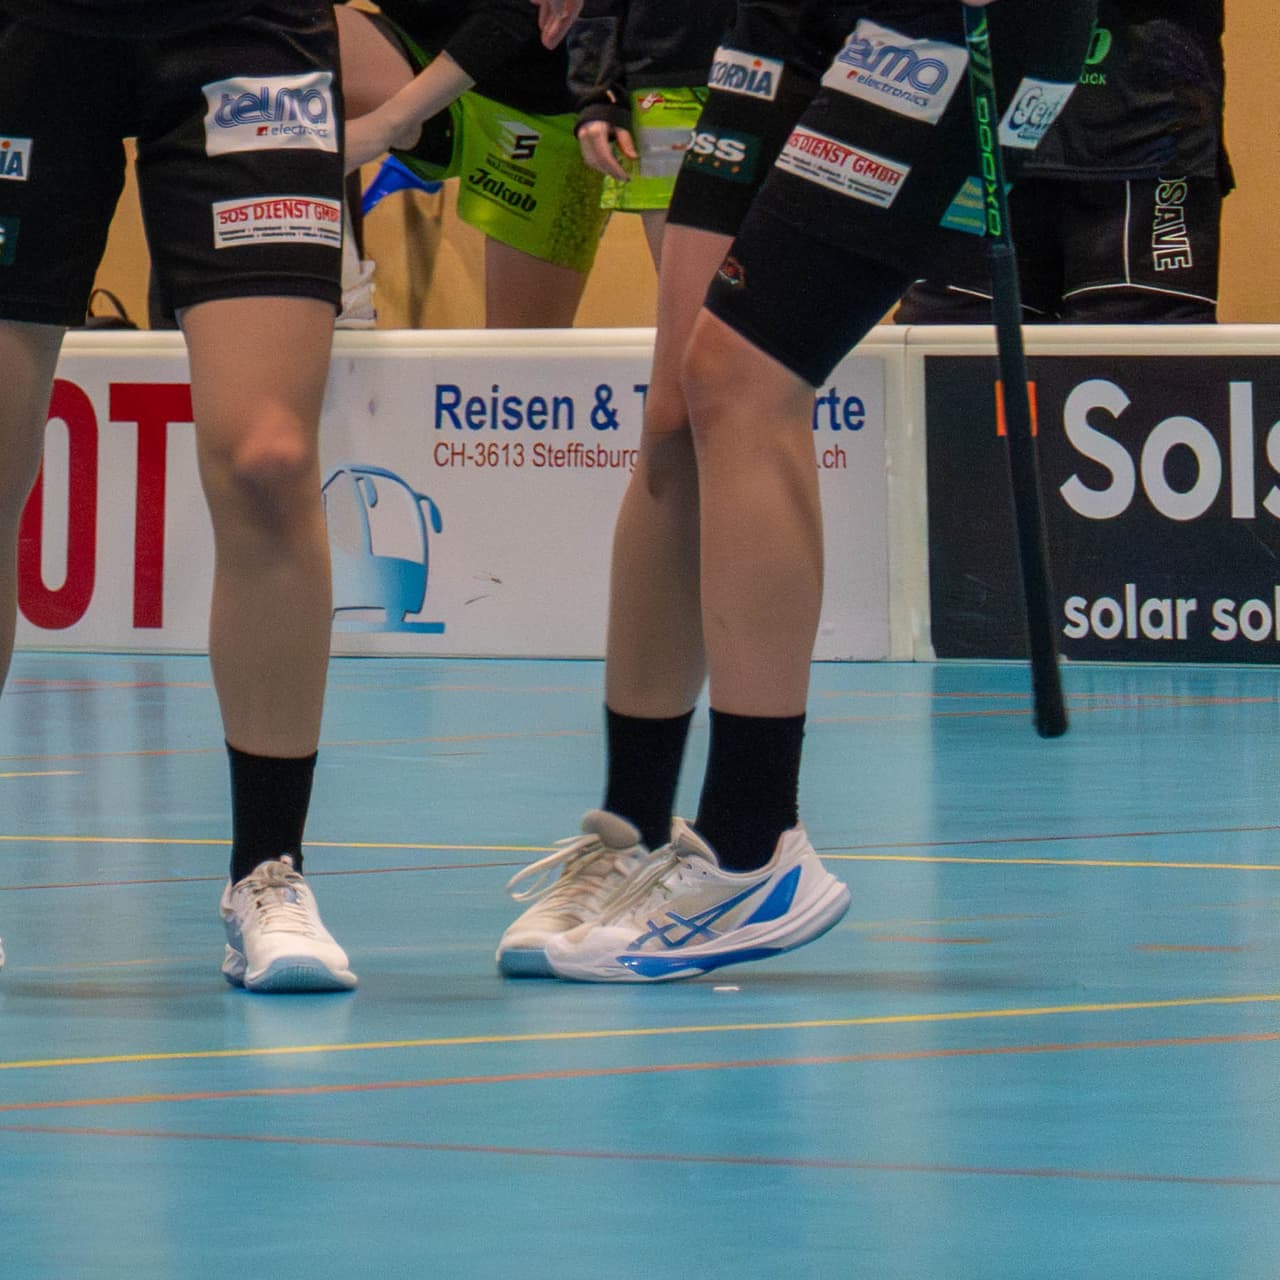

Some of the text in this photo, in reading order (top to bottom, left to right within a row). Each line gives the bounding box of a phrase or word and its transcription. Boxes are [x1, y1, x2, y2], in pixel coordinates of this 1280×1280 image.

[215, 85, 327, 128] telma
[687, 131, 747, 162] SS
[219, 208, 249, 225] SOS
[253, 199, 310, 221] DIENST
[1153, 176, 1193, 273] SAVE
[433, 383, 576, 432] Reisen
[589, 384, 620, 432] &
[433, 441, 525, 469] CH-3613
[1058, 378, 1280, 521] Sol
[1062, 582, 1198, 641] solar
